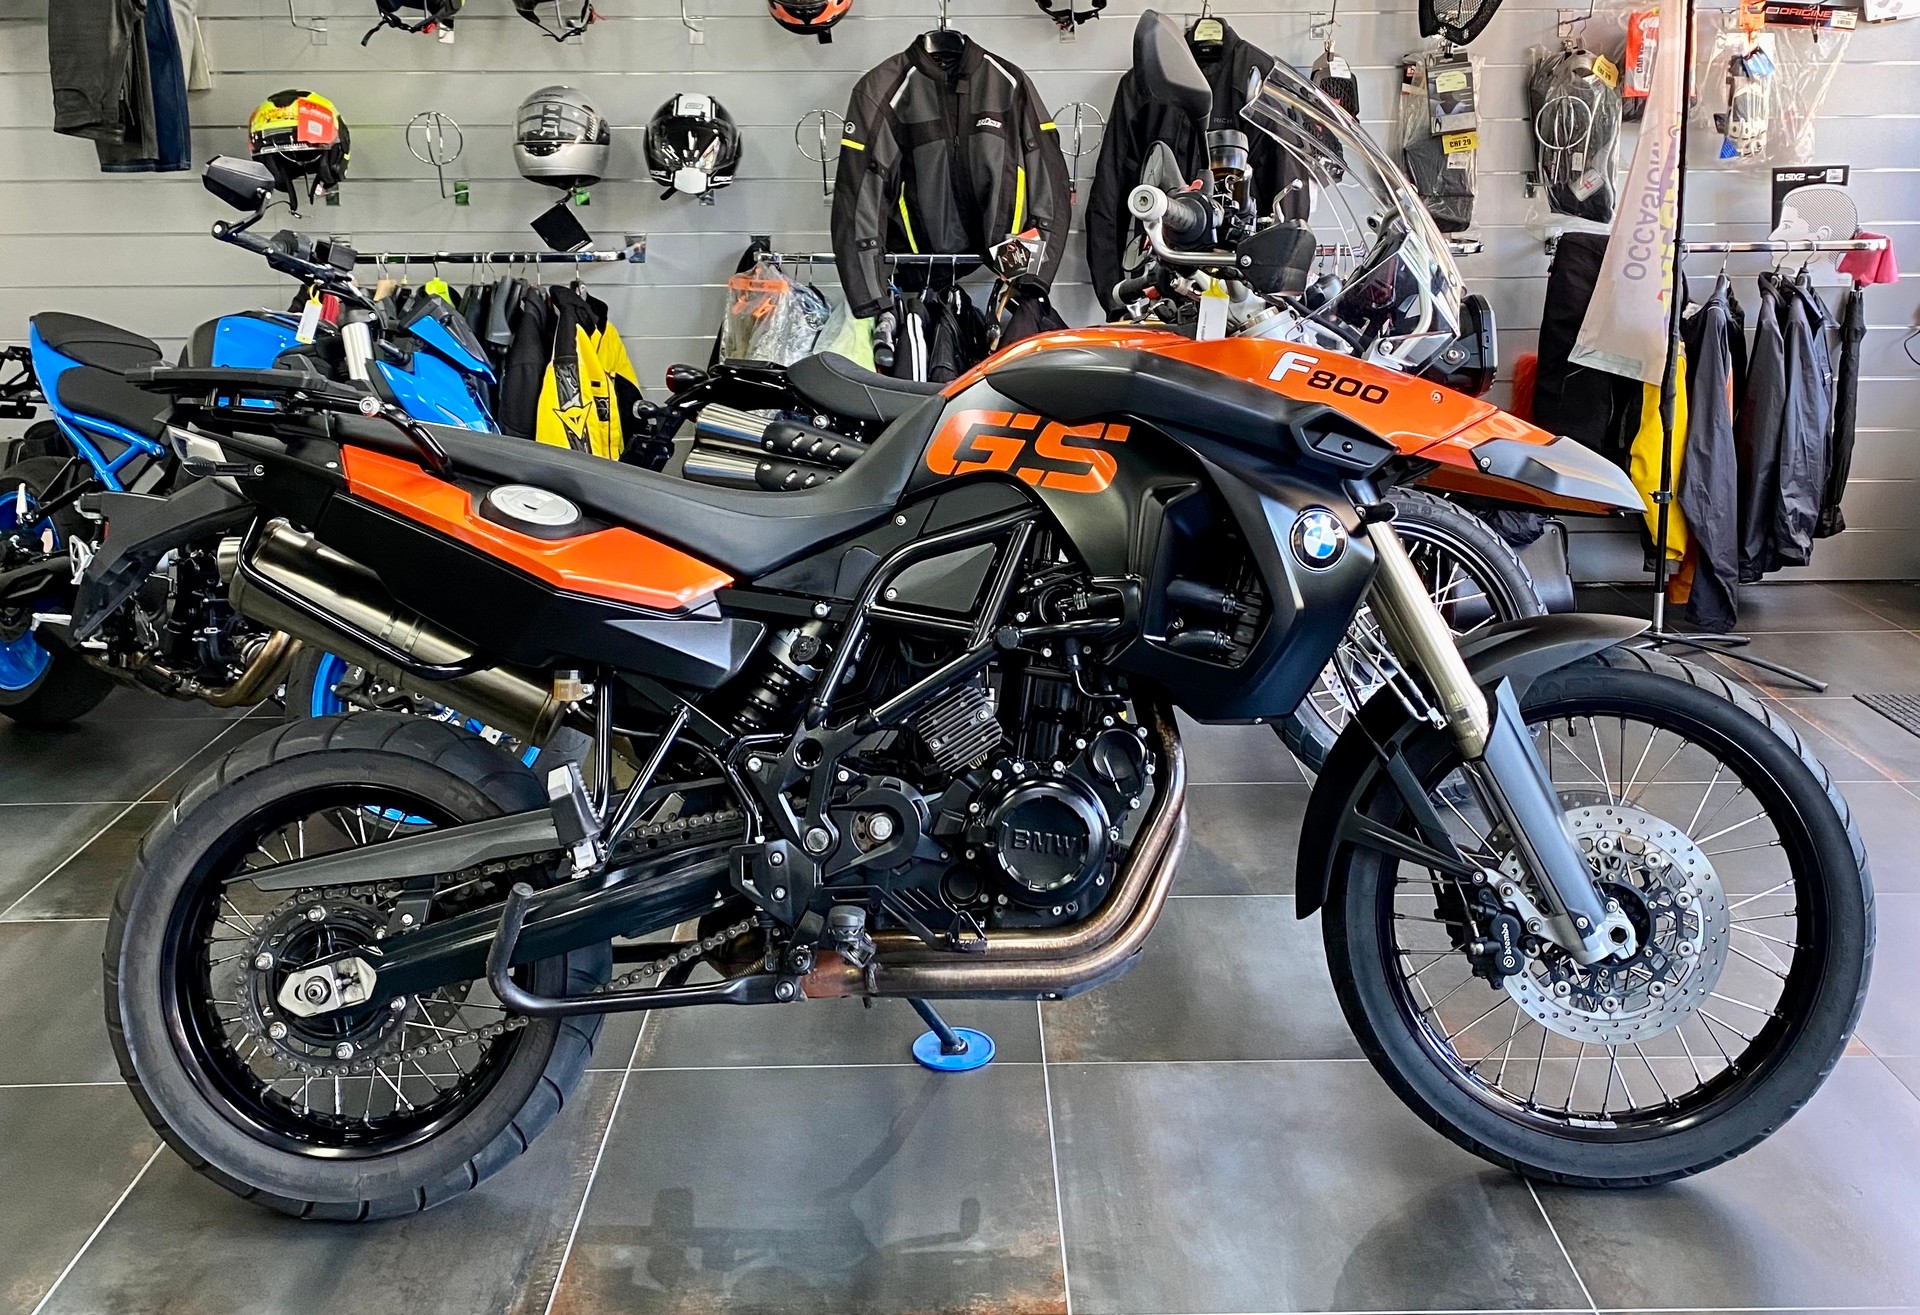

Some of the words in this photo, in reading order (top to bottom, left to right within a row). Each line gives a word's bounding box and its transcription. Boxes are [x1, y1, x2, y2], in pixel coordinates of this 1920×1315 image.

[1779, 7, 1832, 18] ORIGINE
[1267, 350, 1320, 382] F
[1307, 370, 1389, 405] 800
[926, 409, 1131, 494] GS
[1014, 828, 1077, 856] BMW
[1501, 922, 1512, 955] brembo
